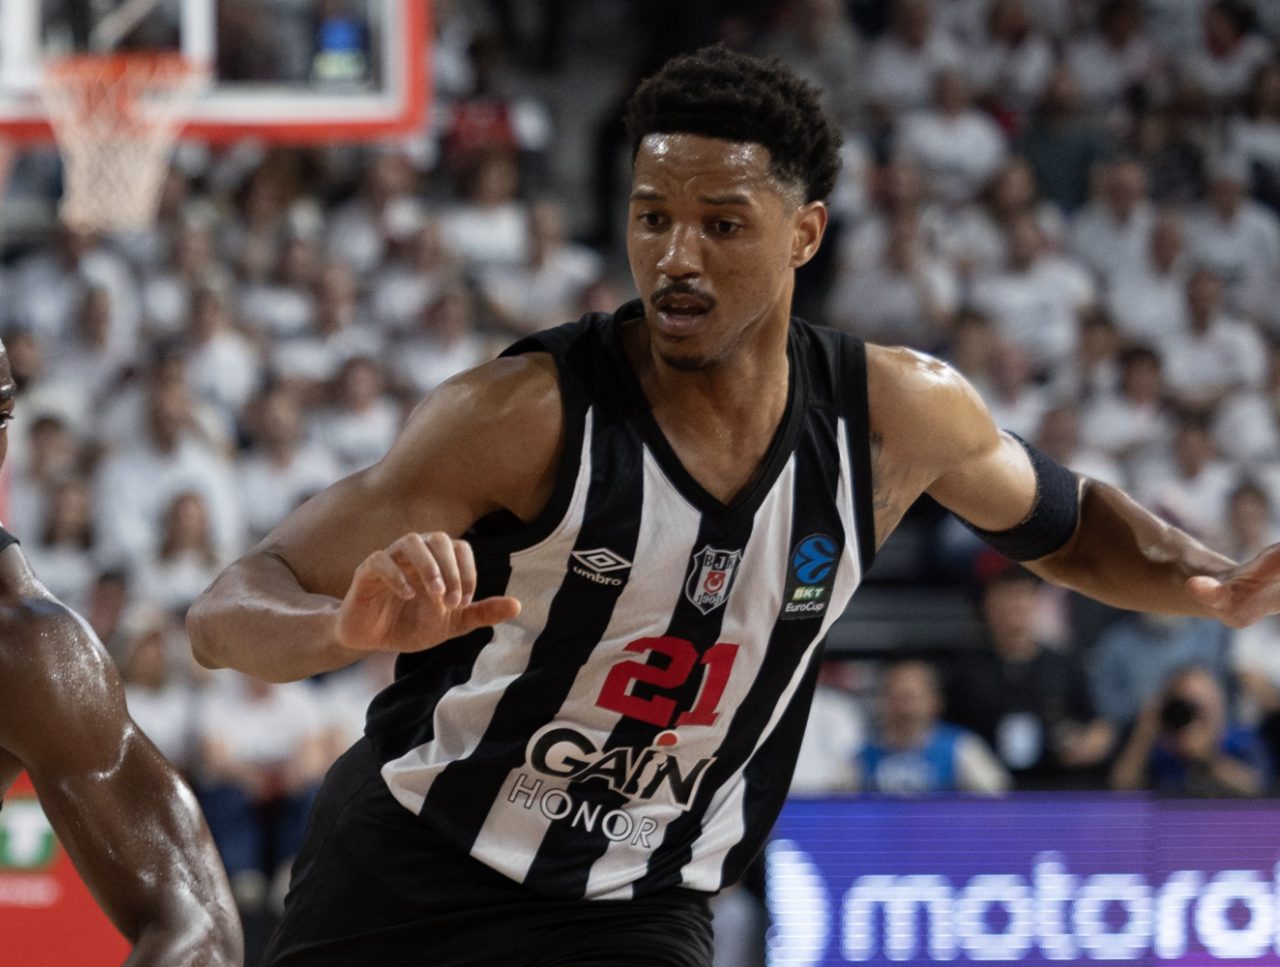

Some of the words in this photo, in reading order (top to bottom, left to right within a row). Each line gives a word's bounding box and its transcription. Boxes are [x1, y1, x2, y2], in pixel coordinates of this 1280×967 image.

[573, 566, 622, 586] umbro
[792, 586, 824, 601] BKT
[785, 602, 825, 613] EuroCup
[595, 635, 740, 728] 21
[508, 773, 658, 848] HONOR
[841, 851, 1280, 961] motoro
